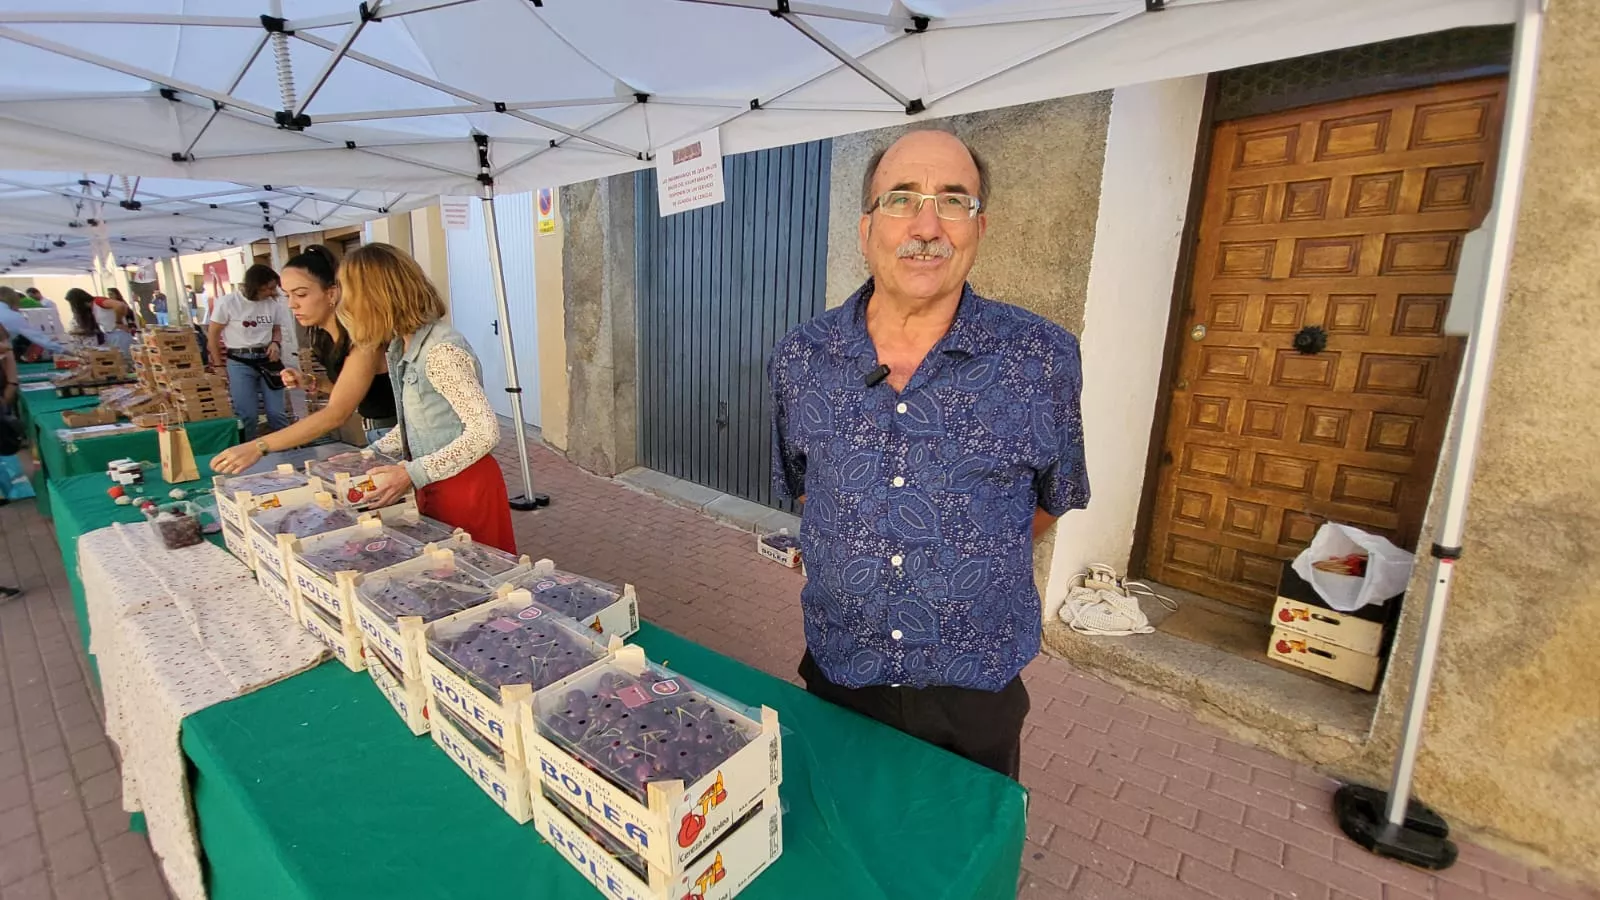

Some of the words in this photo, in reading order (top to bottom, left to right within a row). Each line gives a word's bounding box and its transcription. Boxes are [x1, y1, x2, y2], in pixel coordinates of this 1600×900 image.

[761, 548, 788, 564] BOLEA
[297, 575, 341, 612] BOLEA
[306, 619, 347, 659] BOLEA
[360, 616, 404, 663] BOLEA
[431, 673, 505, 740] BOLEA
[440, 728, 507, 802] BOLEA
[540, 757, 649, 849] BOLEA
[549, 823, 635, 900] BOLE
[679, 840, 703, 863] Cereza
[702, 832, 711, 843] de
[712, 817, 730, 836] Bolea
